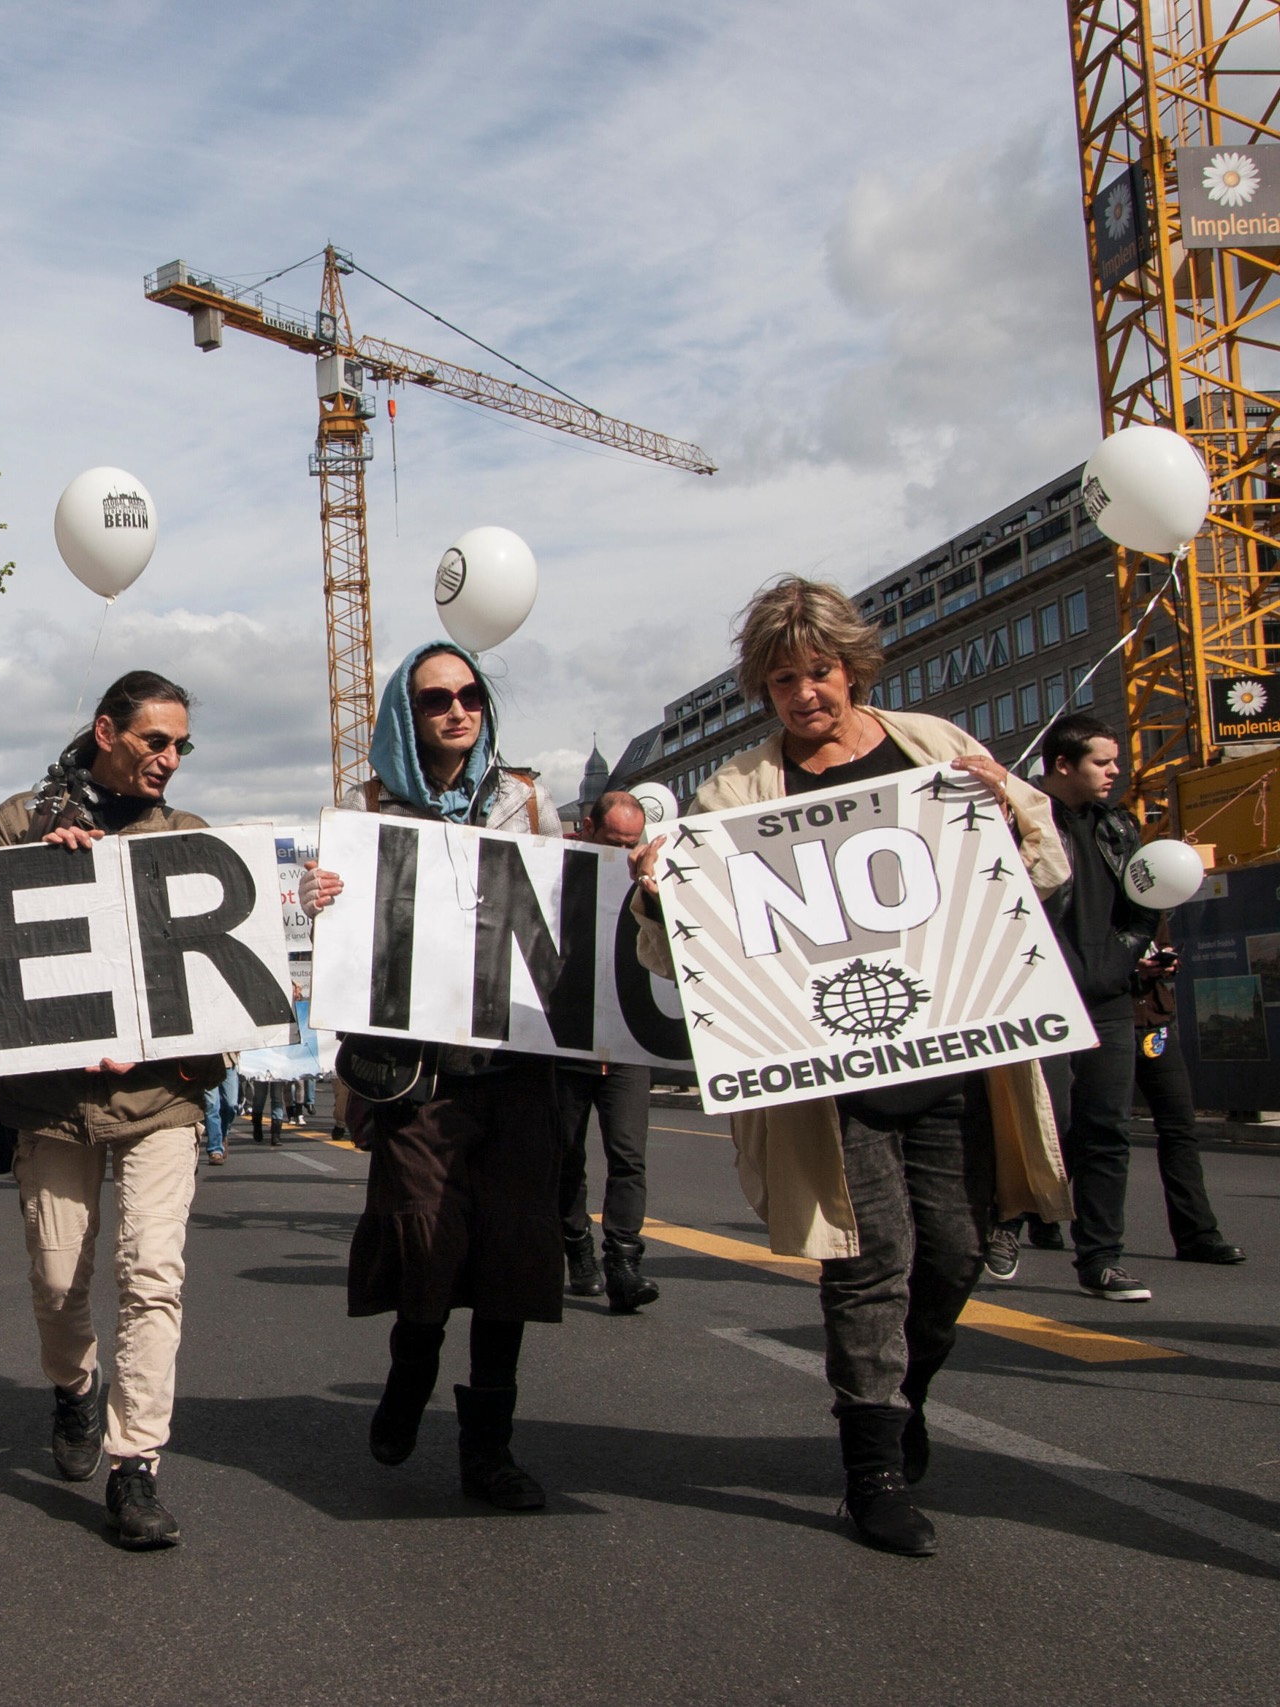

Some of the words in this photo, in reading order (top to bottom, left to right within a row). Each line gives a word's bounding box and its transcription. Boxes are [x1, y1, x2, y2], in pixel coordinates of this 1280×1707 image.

[104, 512, 148, 529] BERLIN
[1219, 718, 1280, 739] Implenia
[757, 799, 858, 838] STOP
[870, 792, 882, 815] !
[725, 826, 941, 959] NO
[707, 1013, 1070, 1102] GEOENGINEERING
